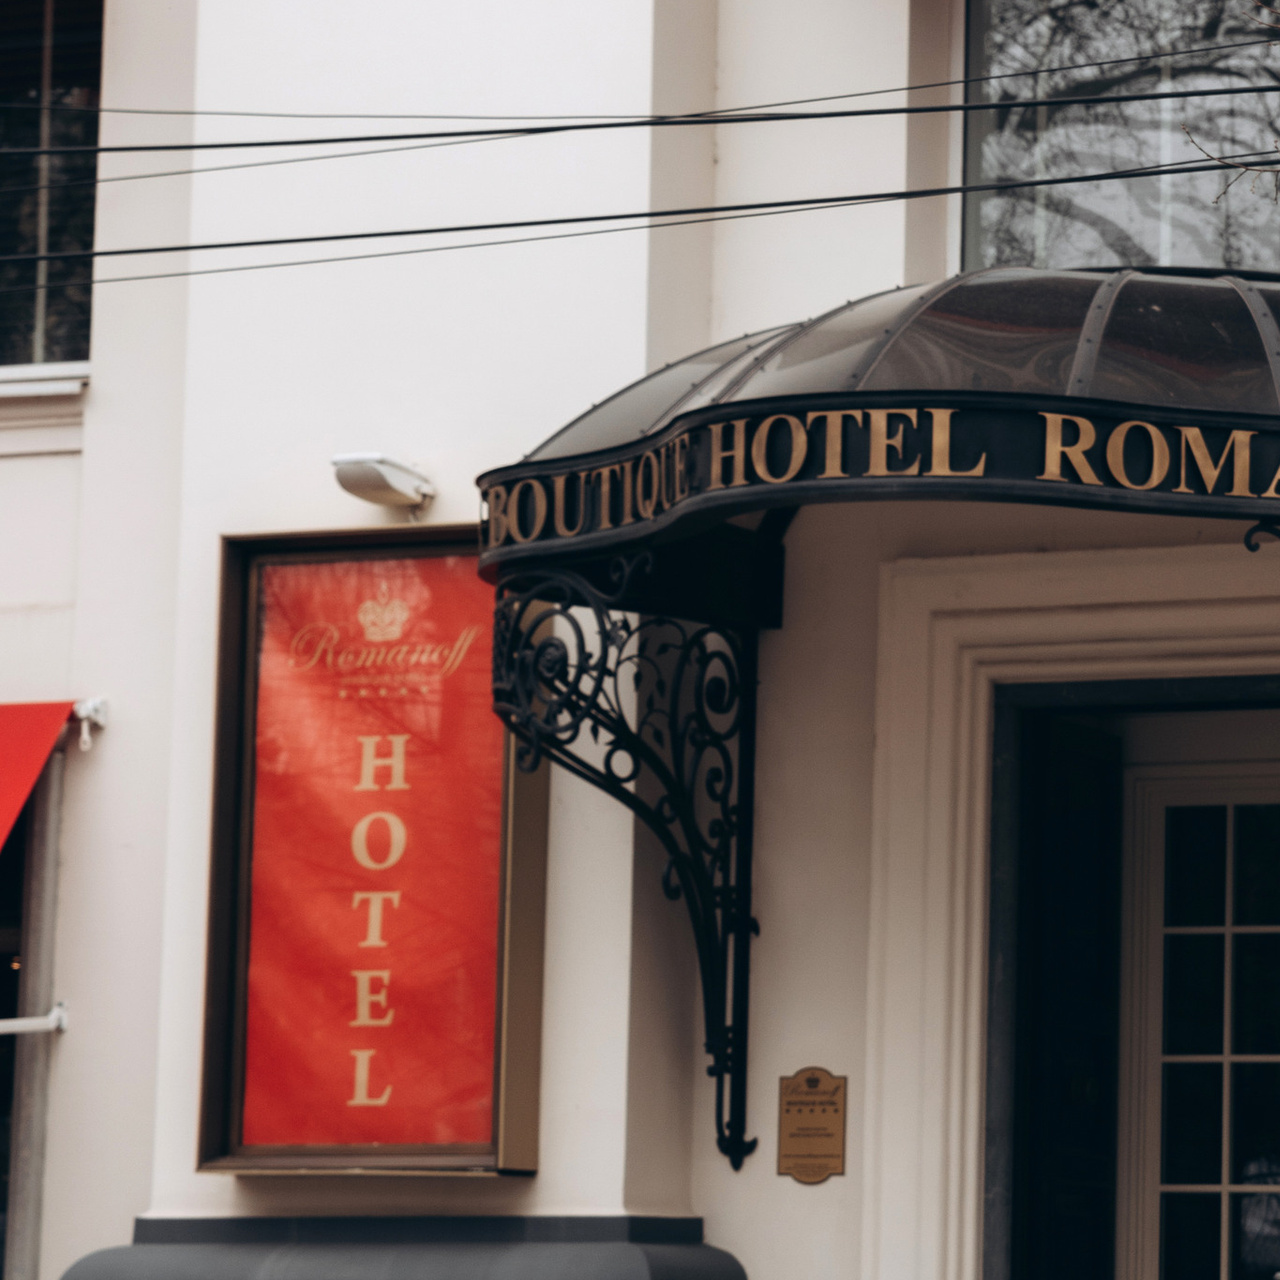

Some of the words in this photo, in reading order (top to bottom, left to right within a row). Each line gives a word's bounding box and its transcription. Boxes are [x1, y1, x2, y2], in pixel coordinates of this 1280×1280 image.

[488, 432, 690, 548] BOUTIQUE
[706, 407, 988, 491] HOTEL
[288, 621, 484, 678] Romanoff
[346, 733, 411, 1107] HOTEL
